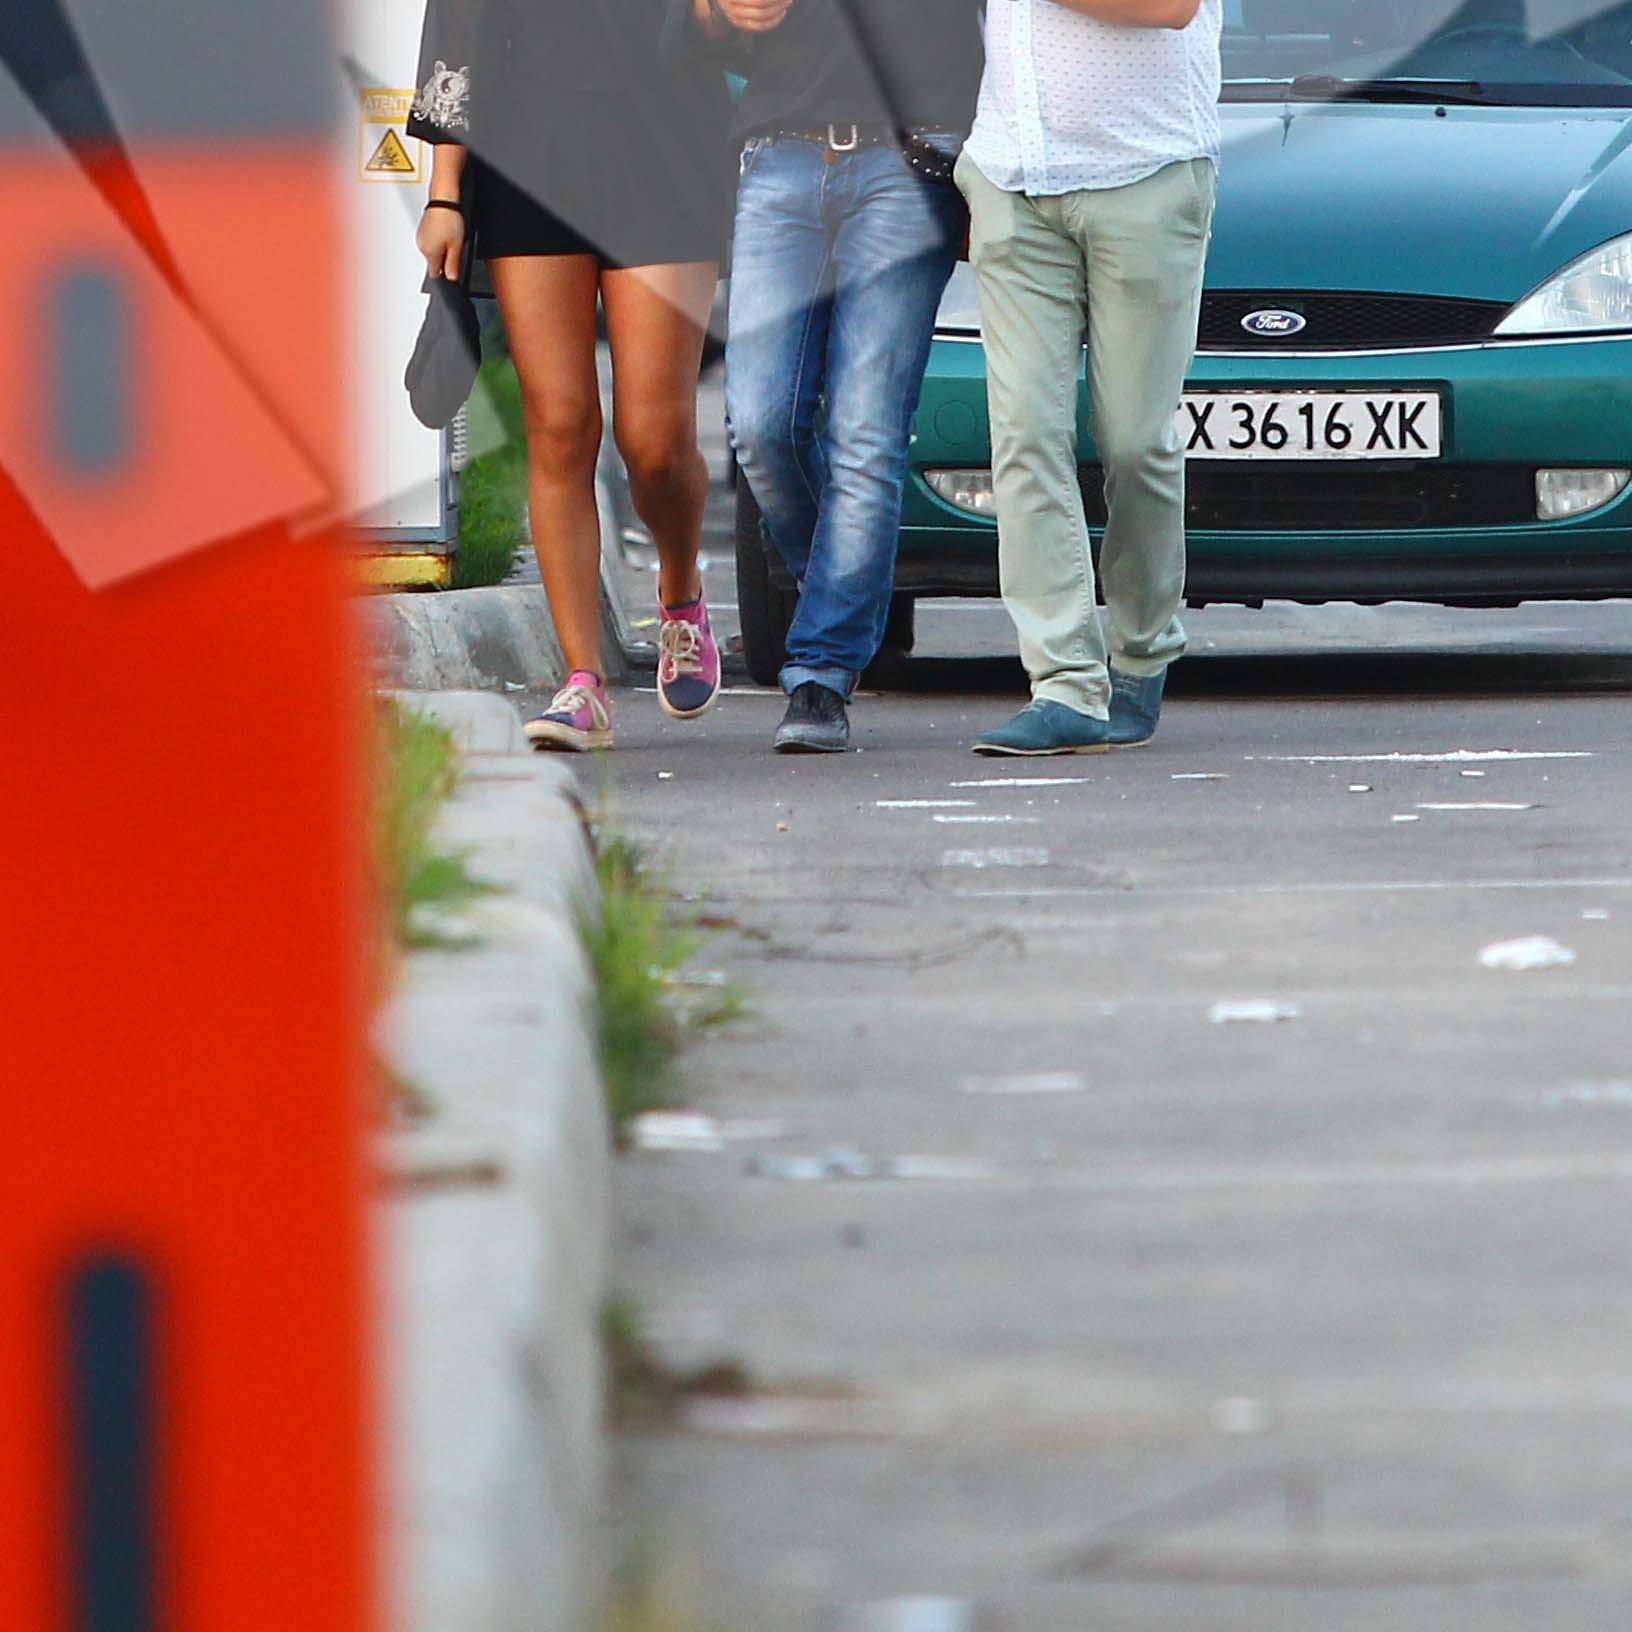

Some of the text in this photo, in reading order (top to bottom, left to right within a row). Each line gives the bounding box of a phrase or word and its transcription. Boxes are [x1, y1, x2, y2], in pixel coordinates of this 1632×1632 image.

[1255, 314, 1291, 330] Ford
[1179, 401, 1429, 450] X 3616 XK
